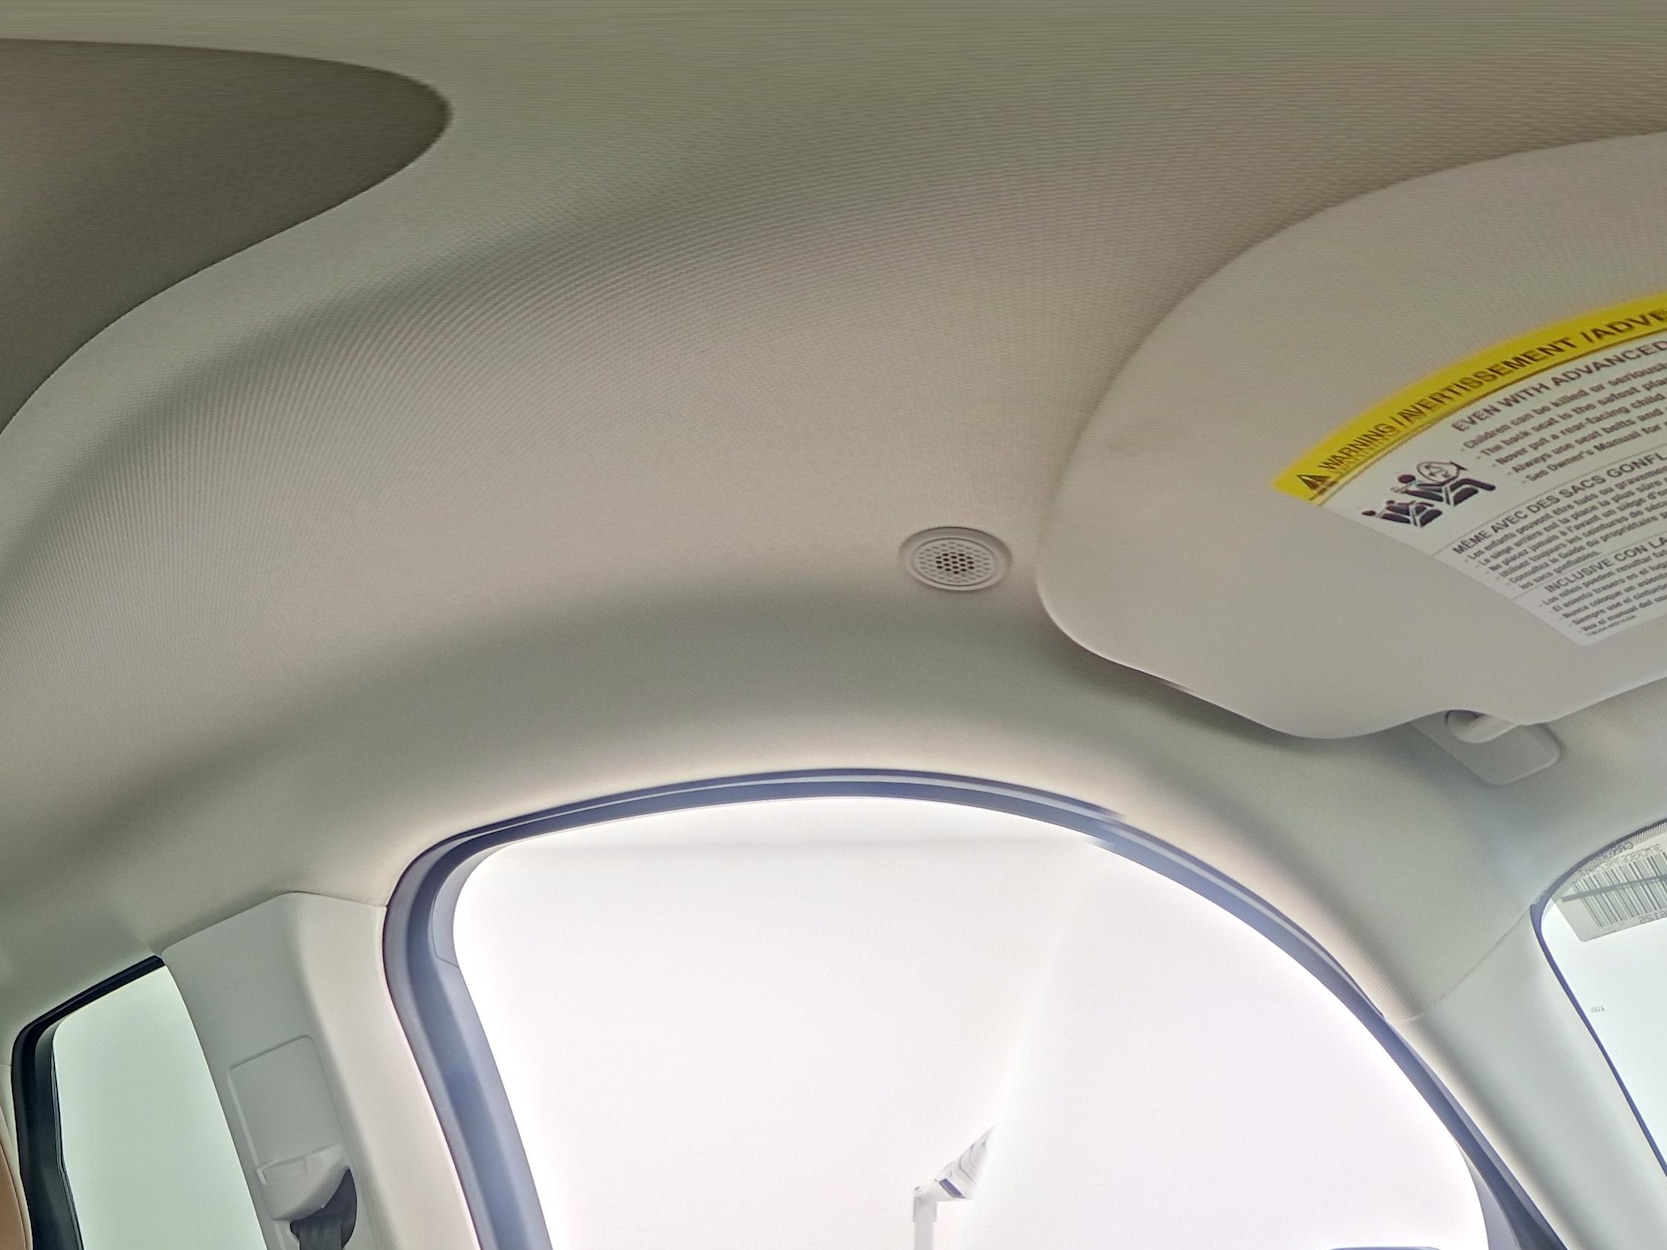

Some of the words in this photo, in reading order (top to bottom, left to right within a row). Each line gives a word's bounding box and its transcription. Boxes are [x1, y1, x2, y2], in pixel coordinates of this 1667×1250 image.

[1451, 405, 1502, 432] EVEN
[1496, 383, 1552, 407] WITH
[1318, 422, 1394, 472] WARNING
[1487, 510, 1529, 534] AVEC
[1523, 495, 1561, 514] DES
[1558, 475, 1607, 498] SACS
[1544, 559, 1615, 592] INCLUSIVE
[1614, 545, 1649, 562] CON
